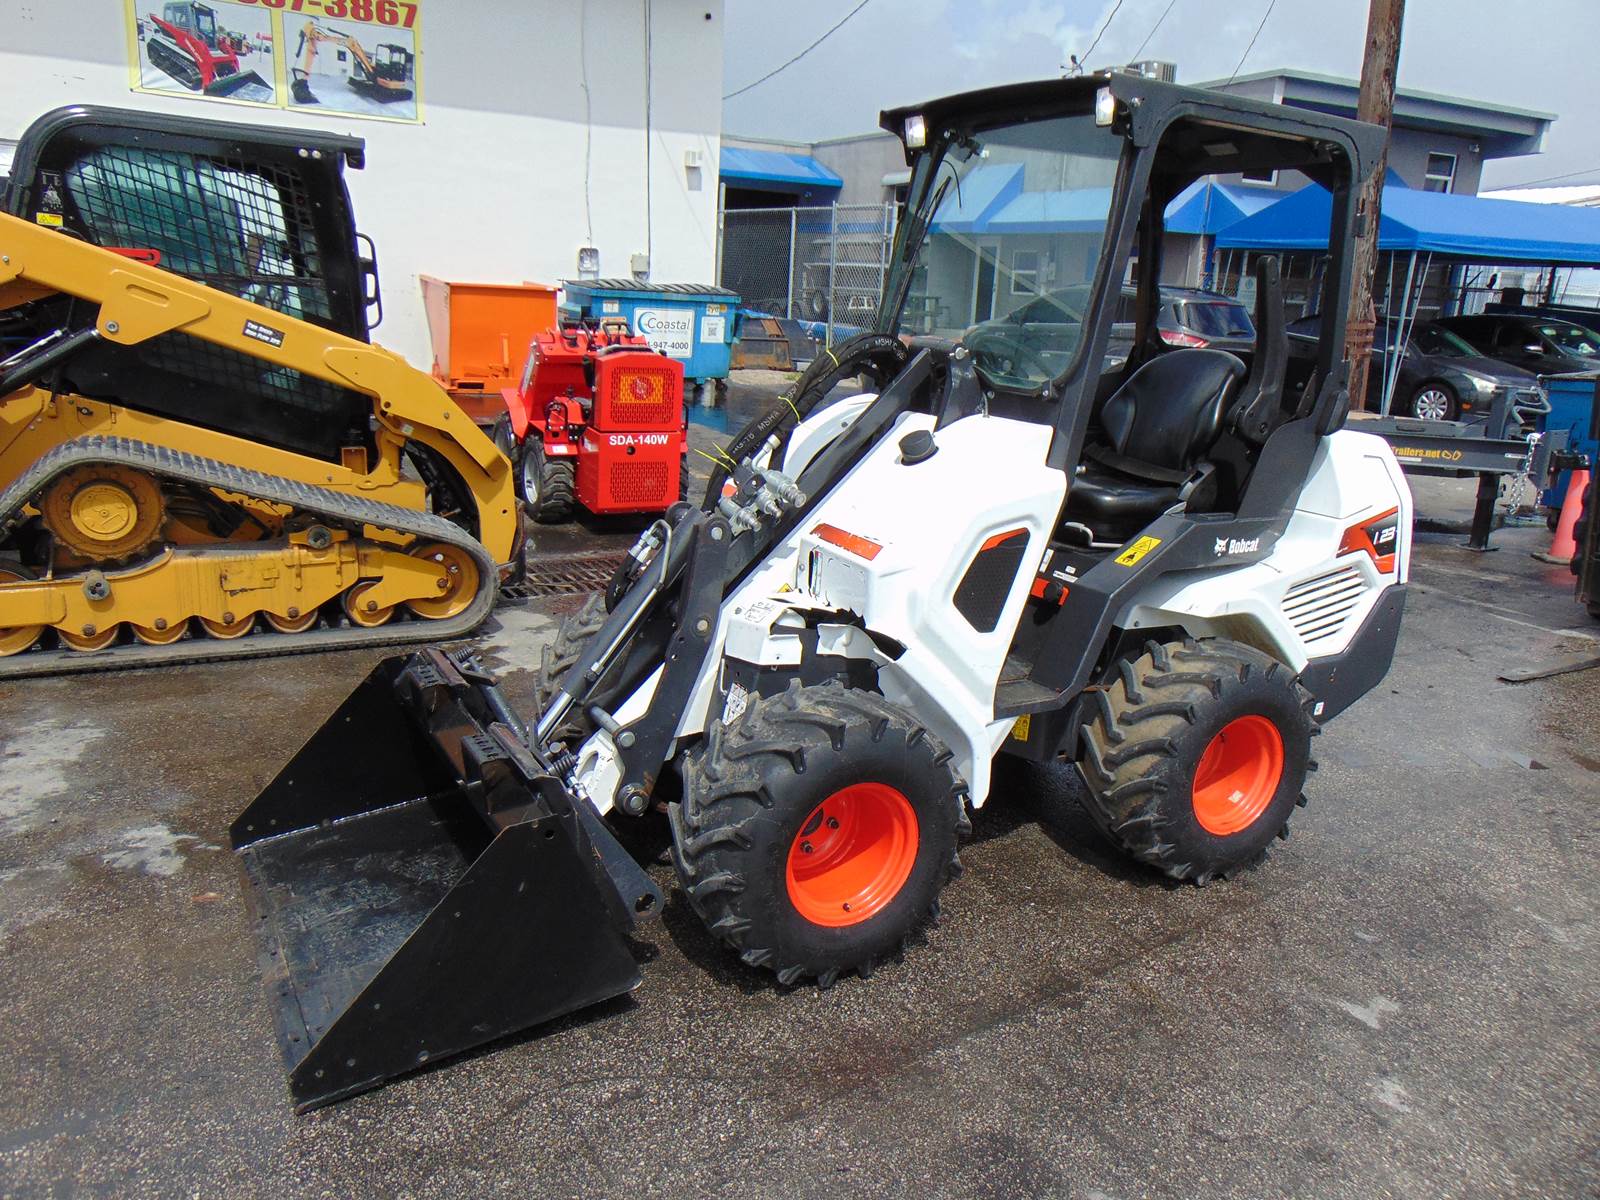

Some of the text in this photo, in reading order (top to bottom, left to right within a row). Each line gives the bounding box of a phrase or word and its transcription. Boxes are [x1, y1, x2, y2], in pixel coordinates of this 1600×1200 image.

[243, 0, 417, 28] -3867
[647, 317, 691, 330] Coastal
[609, 434, 669, 446] SDA-140W
[1228, 537, 1260, 554] Bobcat
